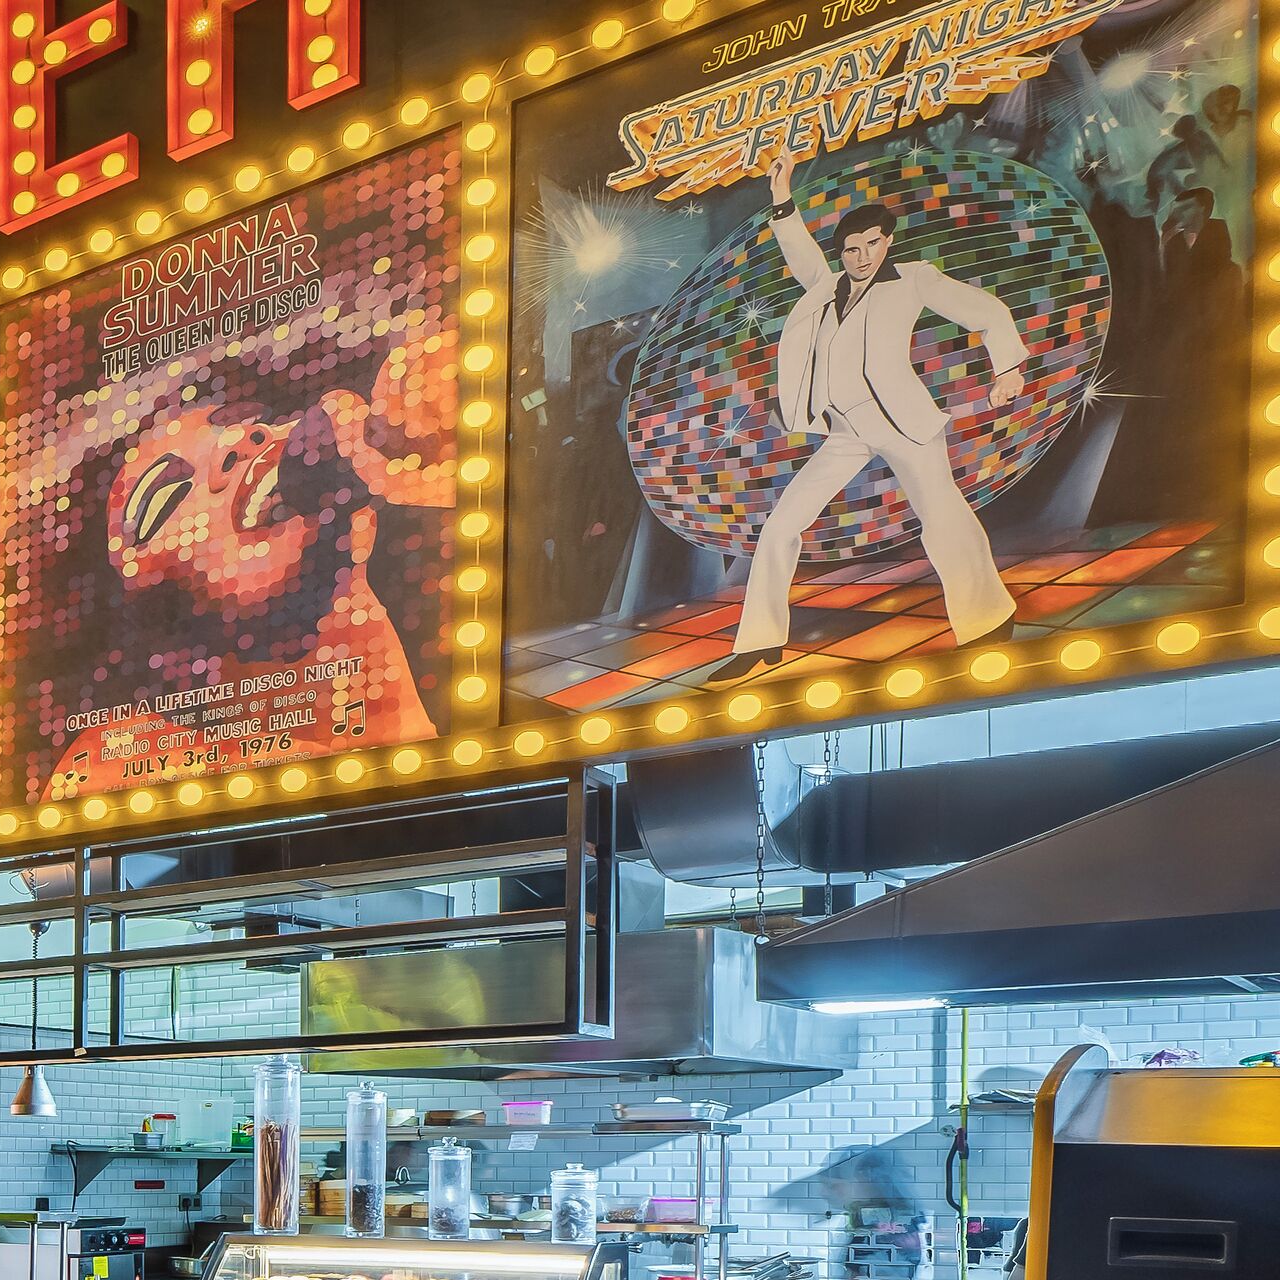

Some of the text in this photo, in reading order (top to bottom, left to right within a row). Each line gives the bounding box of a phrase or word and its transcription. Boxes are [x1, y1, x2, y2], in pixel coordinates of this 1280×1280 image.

[702, 14, 807, 73] JOHN
[607, 36, 900, 190] SATURDAY
[740, 60, 951, 172] FEVER
[104, 234, 320, 349] SUMMER
[122, 203, 298, 302] DONNA
[102, 279, 321, 380] THE QUEEN OF DISCO
[66, 656, 363, 731] ONCE IN A LIFETIME DISCO NIGHT
[101, 690, 317, 741] INCLUDING THE KINGS OF DISCO
[101, 708, 317, 761] RADIO CITY MUSIC HALL
[122, 732, 292, 780] JULY 3rd, 1976
